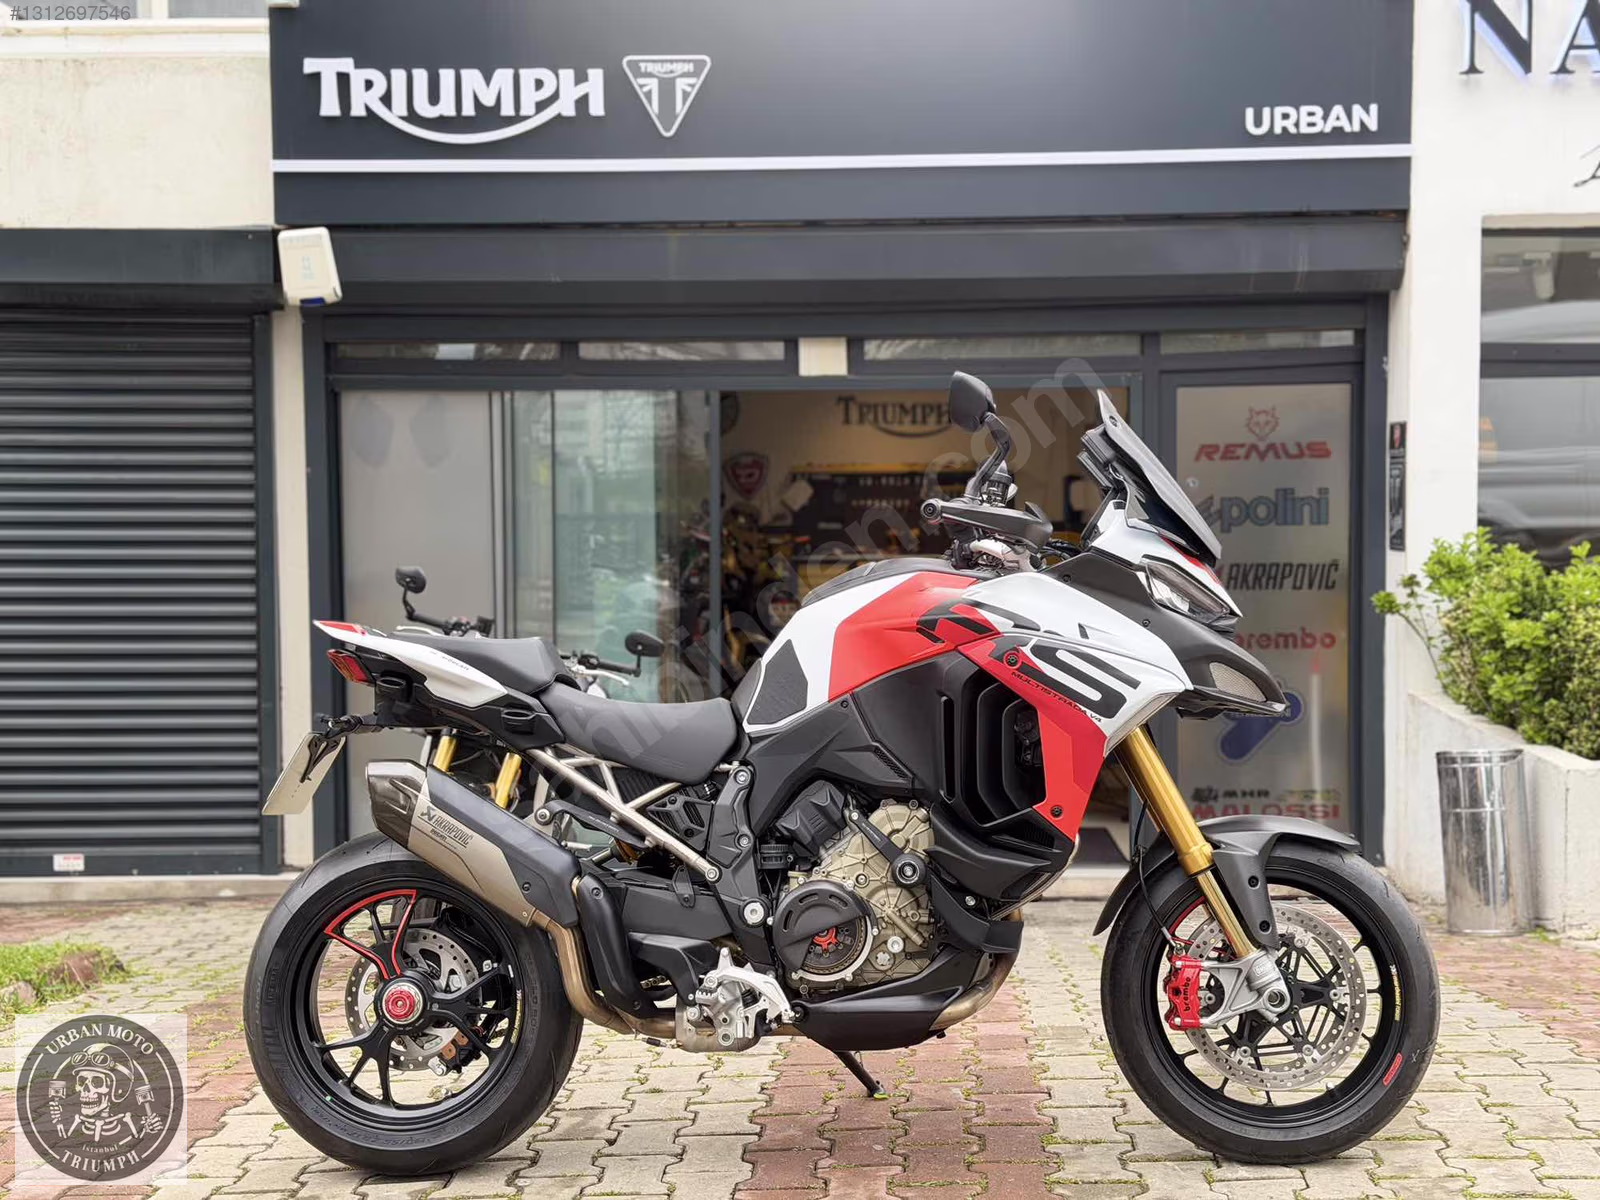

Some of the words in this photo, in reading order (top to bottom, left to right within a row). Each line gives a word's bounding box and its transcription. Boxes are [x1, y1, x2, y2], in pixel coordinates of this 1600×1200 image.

[638, 62, 694, 76] TRIUMPH
[303, 57, 605, 144] TRIUMPH
[1245, 103, 1379, 136] URBAN
[1194, 441, 1332, 462] REMUS
[1220, 487, 1330, 533] polini
[1226, 559, 1340, 591] AKRAPOVIČ
[1010, 670, 1088, 717] MULTISTRADA
[1088, 711, 1103, 724] V4
[1183, 976, 1192, 1013] brembo
